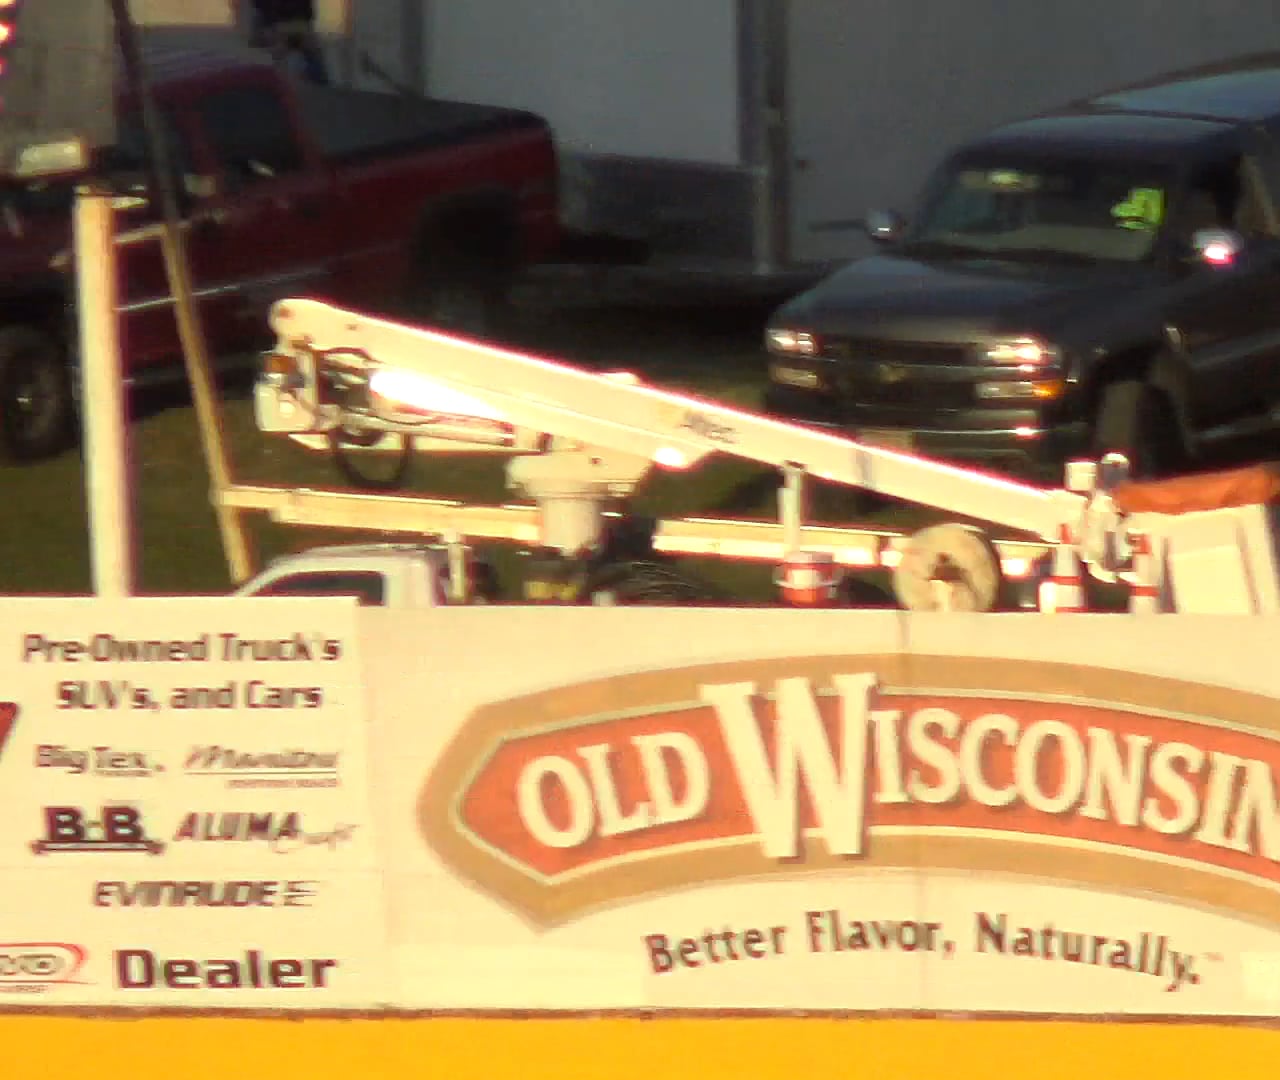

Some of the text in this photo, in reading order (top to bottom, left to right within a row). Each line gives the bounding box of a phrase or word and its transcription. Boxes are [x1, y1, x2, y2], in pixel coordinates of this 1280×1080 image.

[21, 633, 342, 663] Pre-Owned Truck's
[170, 681, 238, 710] and
[245, 680, 324, 710] Cars
[517, 728, 712, 850] OLD
[642, 924, 788, 975] Better
[804, 909, 956, 961] Flavor,
[114, 947, 340, 990] Dealer
